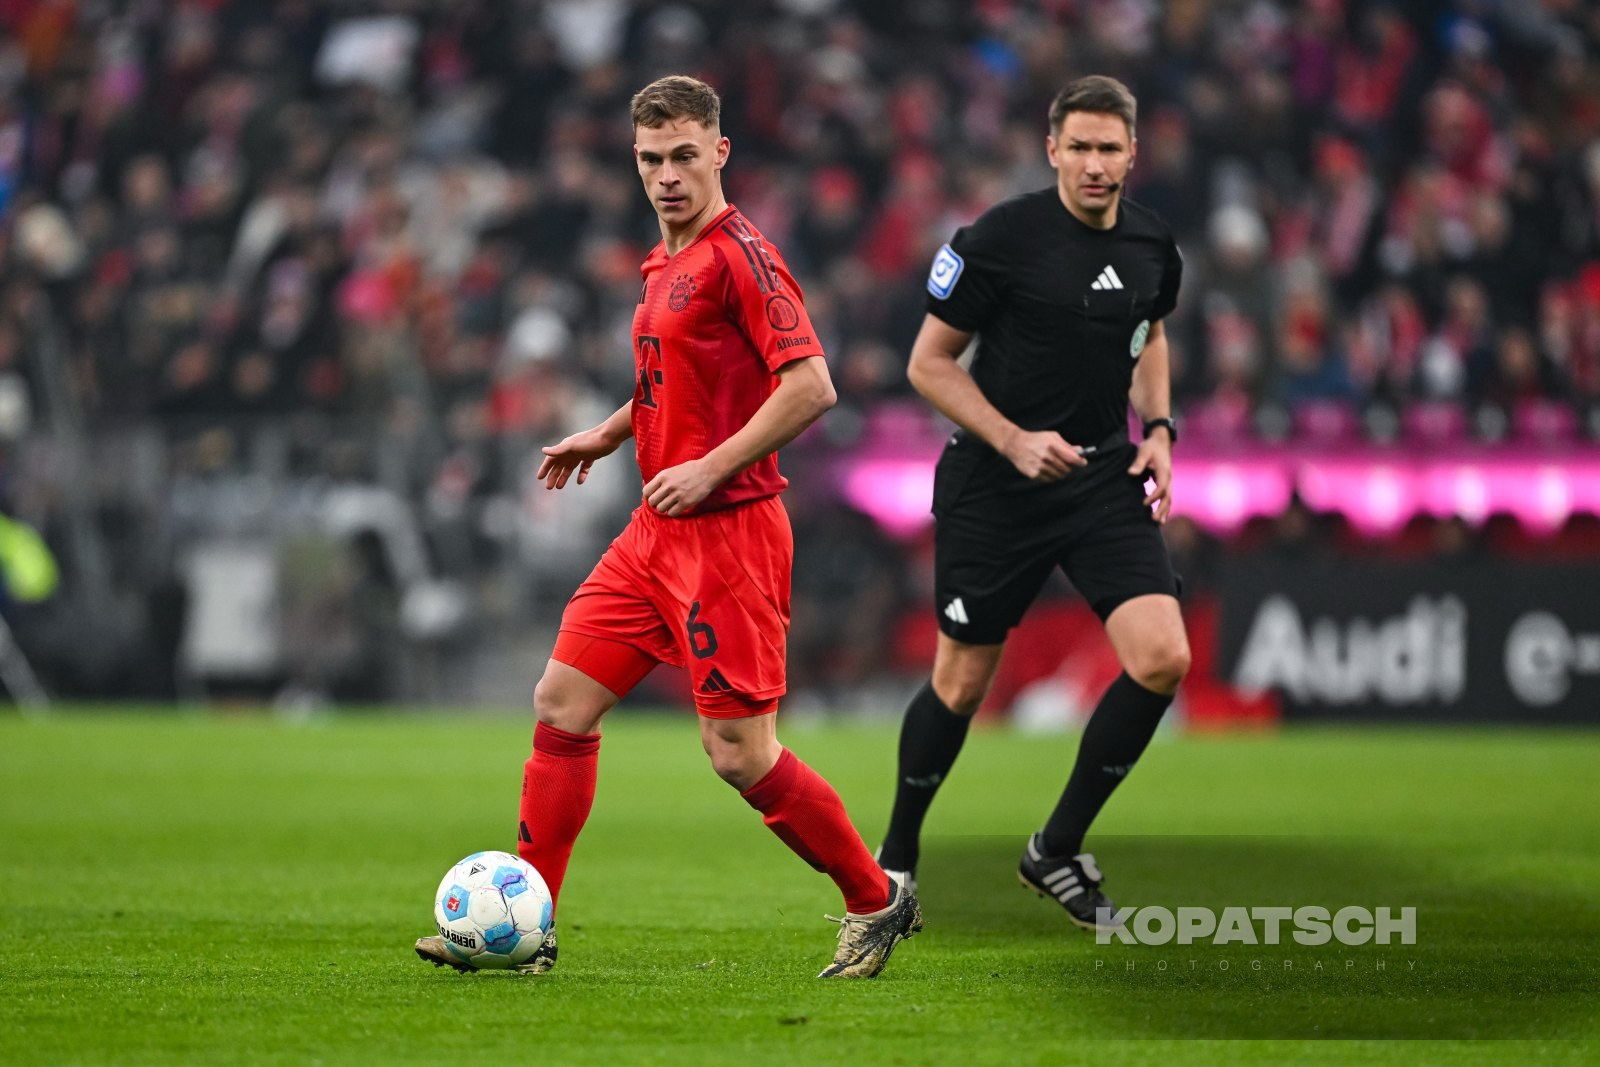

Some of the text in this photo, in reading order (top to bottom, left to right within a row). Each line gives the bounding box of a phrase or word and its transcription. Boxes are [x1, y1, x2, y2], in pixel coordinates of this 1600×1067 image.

[777, 336, 811, 352] Allianz
[686, 601, 719, 660] 6
[1232, 594, 1467, 704] Audi
